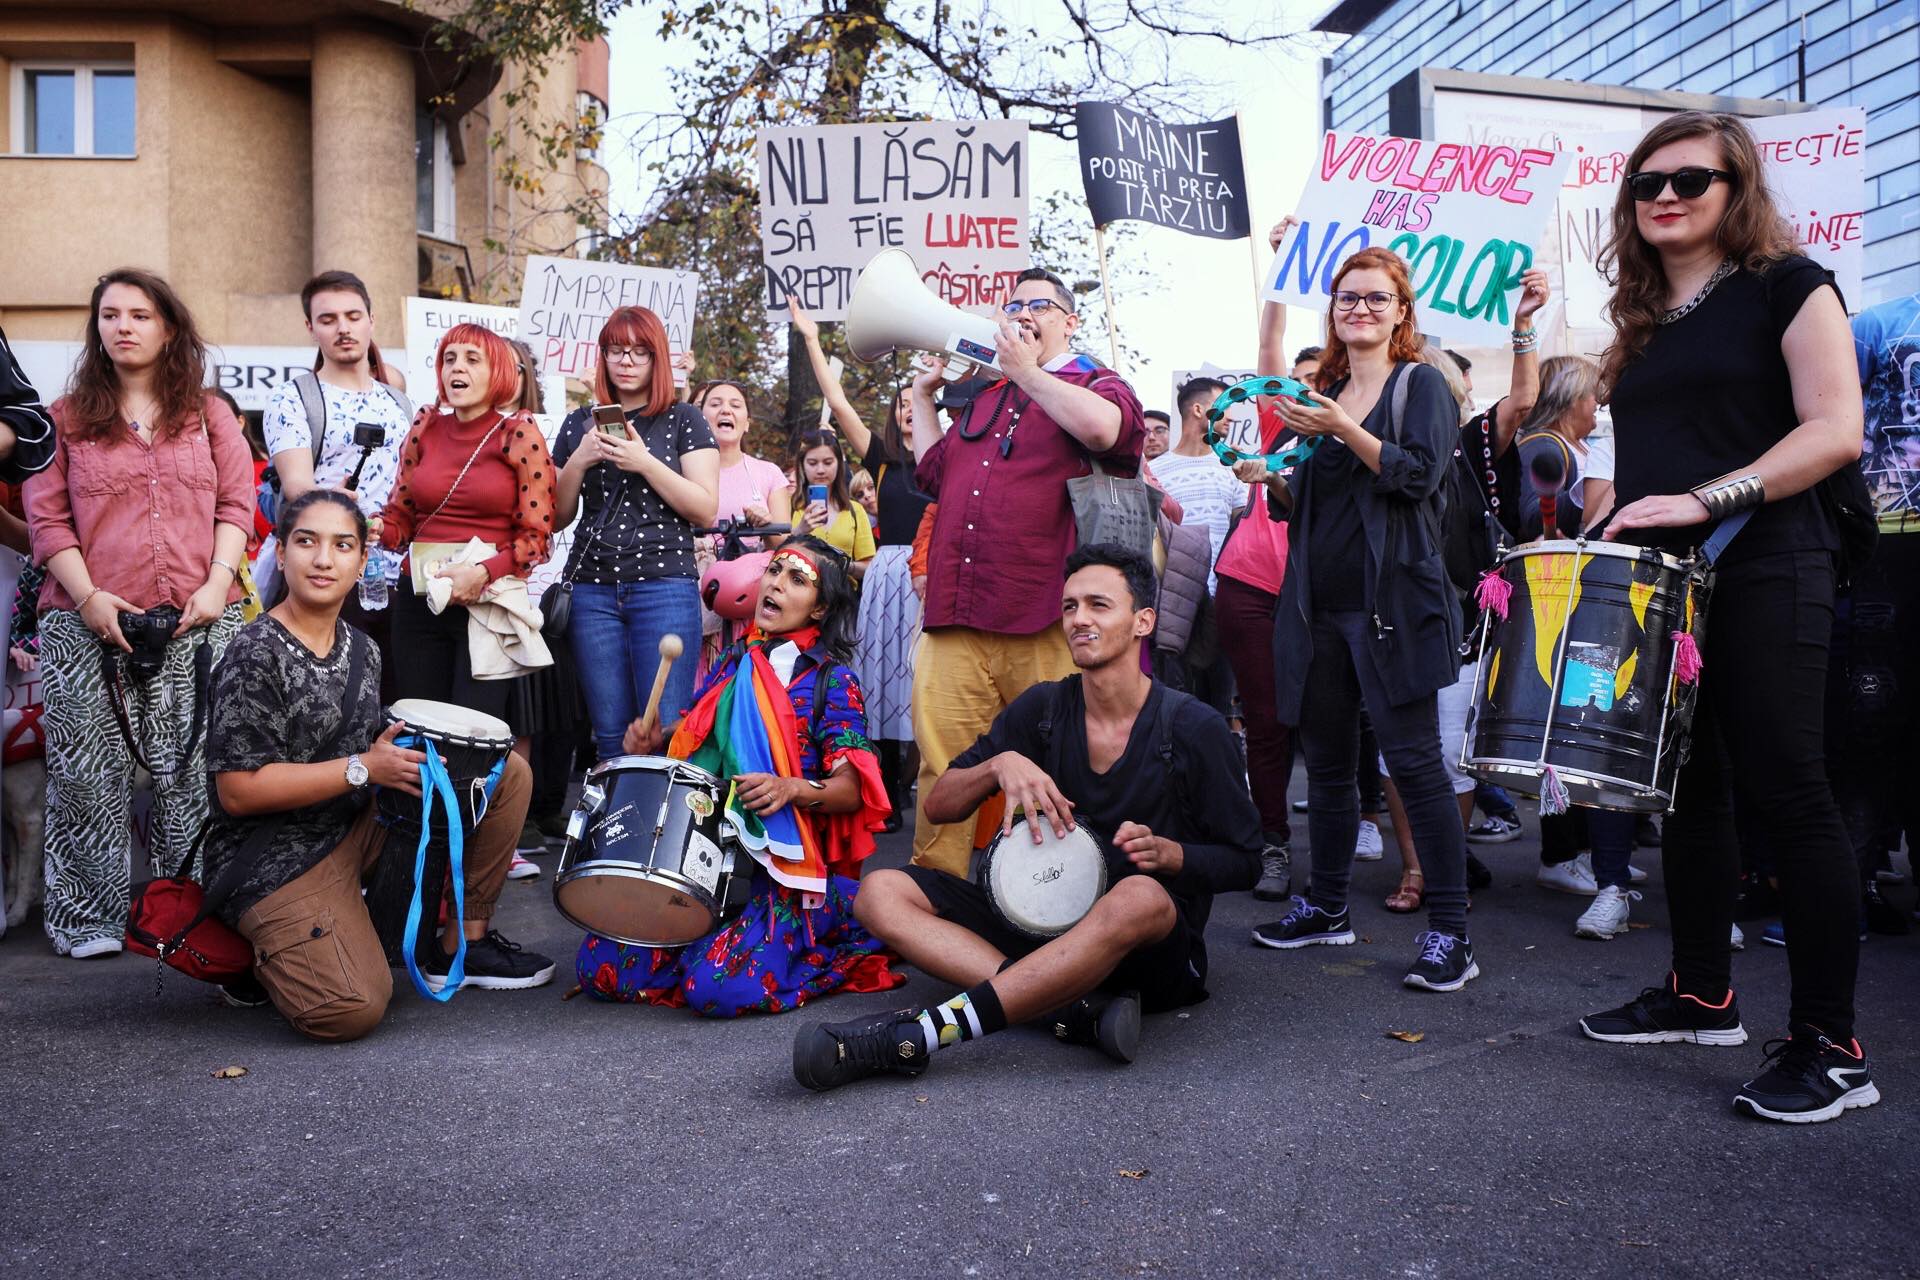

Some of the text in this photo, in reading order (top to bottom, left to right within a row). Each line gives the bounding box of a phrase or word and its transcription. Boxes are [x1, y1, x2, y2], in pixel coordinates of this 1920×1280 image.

[767, 126, 1021, 206] NU LĂSĂM
[1089, 157, 1148, 184] POATE
[1178, 176, 1234, 201] PREA
[770, 210, 815, 256] SĂ
[924, 212, 1020, 249] LUATE
[1361, 189, 1441, 233] HAS
[1273, 220, 1371, 297] NO
